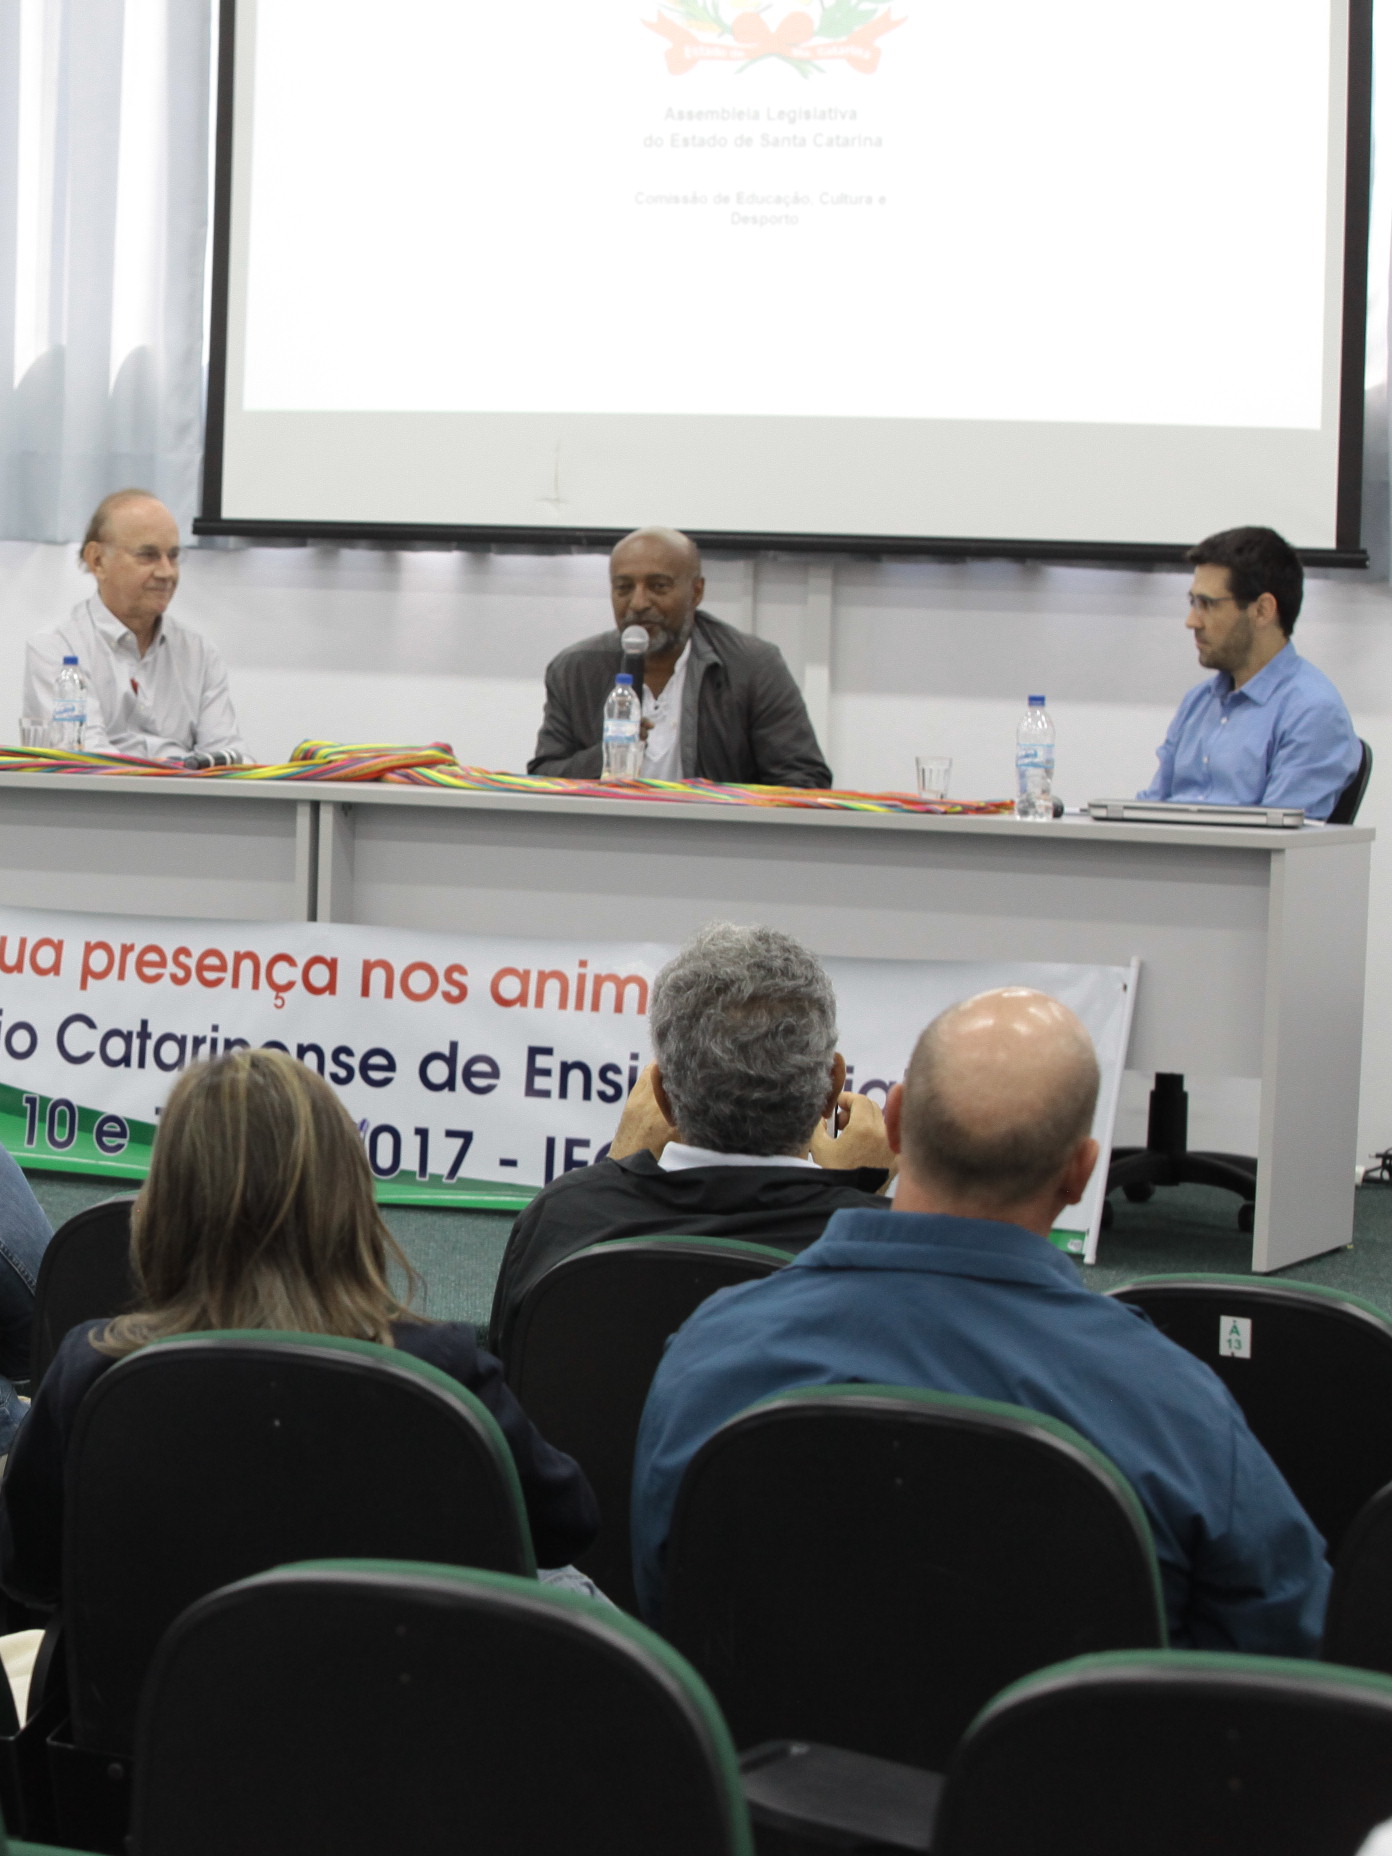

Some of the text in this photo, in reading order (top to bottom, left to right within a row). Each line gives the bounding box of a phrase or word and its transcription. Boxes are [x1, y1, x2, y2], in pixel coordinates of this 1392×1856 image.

[766, 105, 858, 126] Legislativa
[643, 132, 883, 149] do Estado de Santa Catarina
[634, 191, 708, 206] Comissão
[713, 191, 730, 206] de
[819, 191, 873, 206] Cultura
[878, 195, 887, 206] e
[730, 211, 799, 228] Desporto
[78, 937, 339, 1010] presença
[360, 957, 469, 1004] nos
[489, 957, 649, 1015] anim
[419, 1040, 501, 1096] de
[23, 1094, 78, 1150] 10
[94, 1113, 128, 1154] e
[1229, 1323, 1241, 1337] A
[1227, 1338, 1243, 1351] 13
